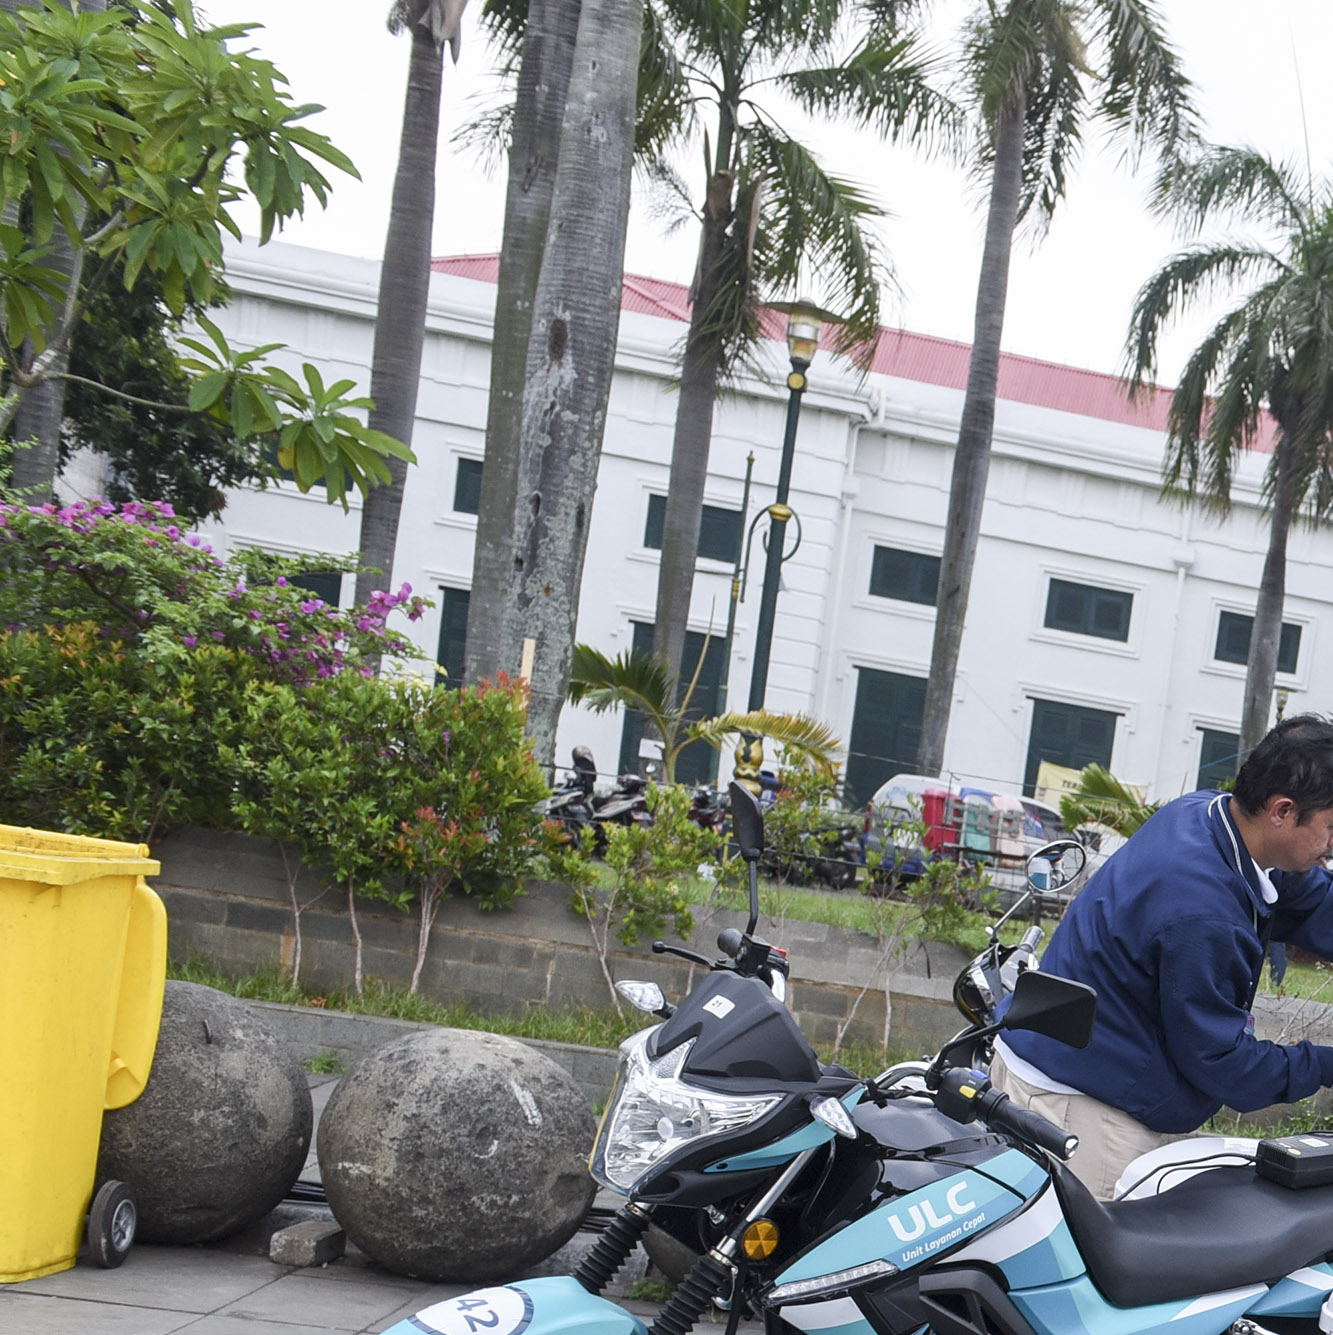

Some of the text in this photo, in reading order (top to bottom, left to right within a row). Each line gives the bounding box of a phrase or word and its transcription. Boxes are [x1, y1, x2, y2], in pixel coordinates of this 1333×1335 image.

[887, 1180, 977, 1242] ULC
[902, 1212, 986, 1262] Unit Layanan Cepat
[455, 1298, 500, 1333] 42
